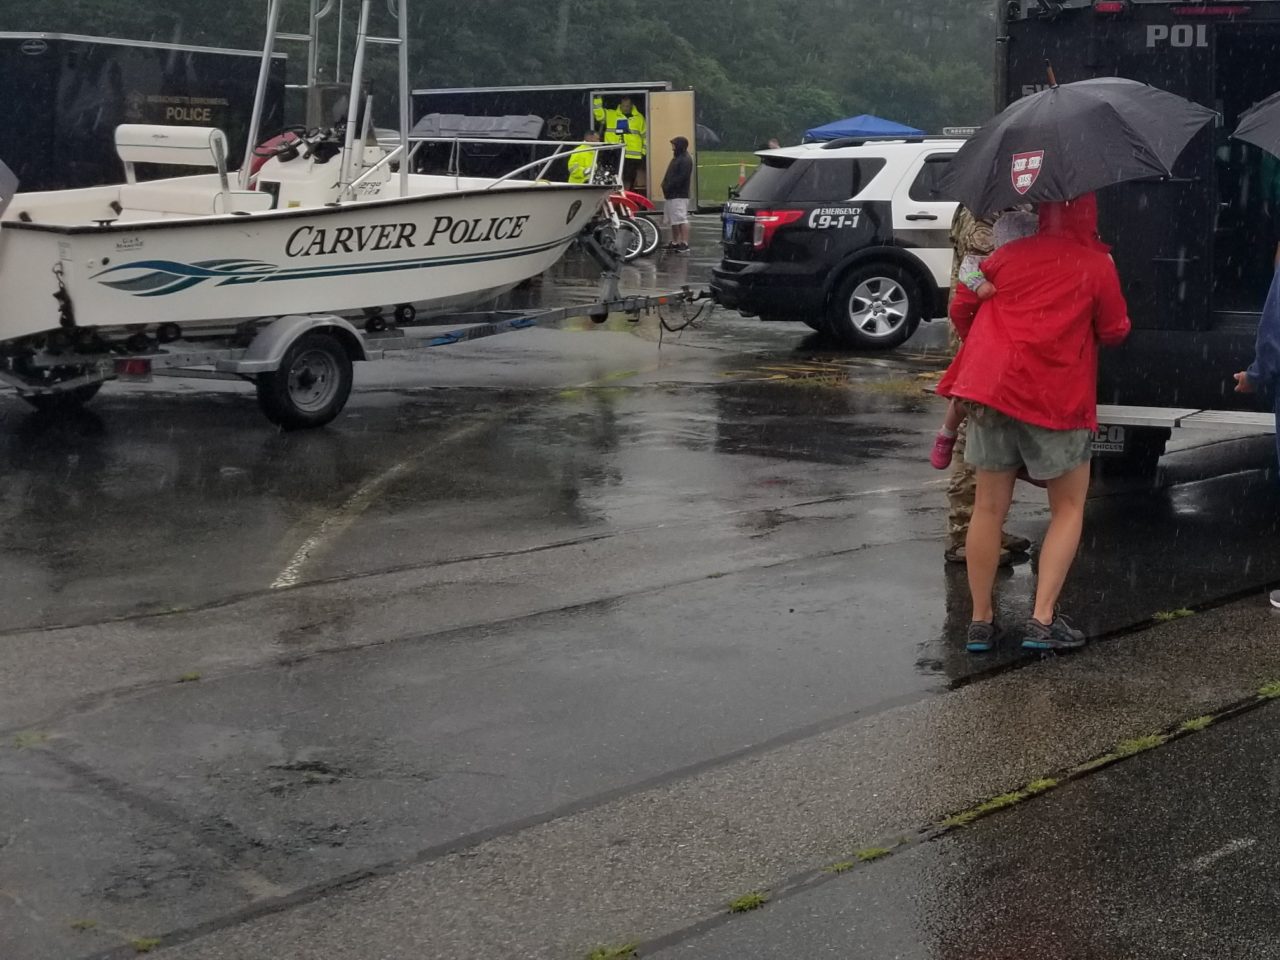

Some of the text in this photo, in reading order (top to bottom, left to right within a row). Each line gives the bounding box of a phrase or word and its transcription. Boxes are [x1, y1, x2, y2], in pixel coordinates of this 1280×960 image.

[166, 107, 211, 121] POLICE
[818, 215, 859, 228] 9-1-1
[285, 215, 530, 257] CARVER POLICE
